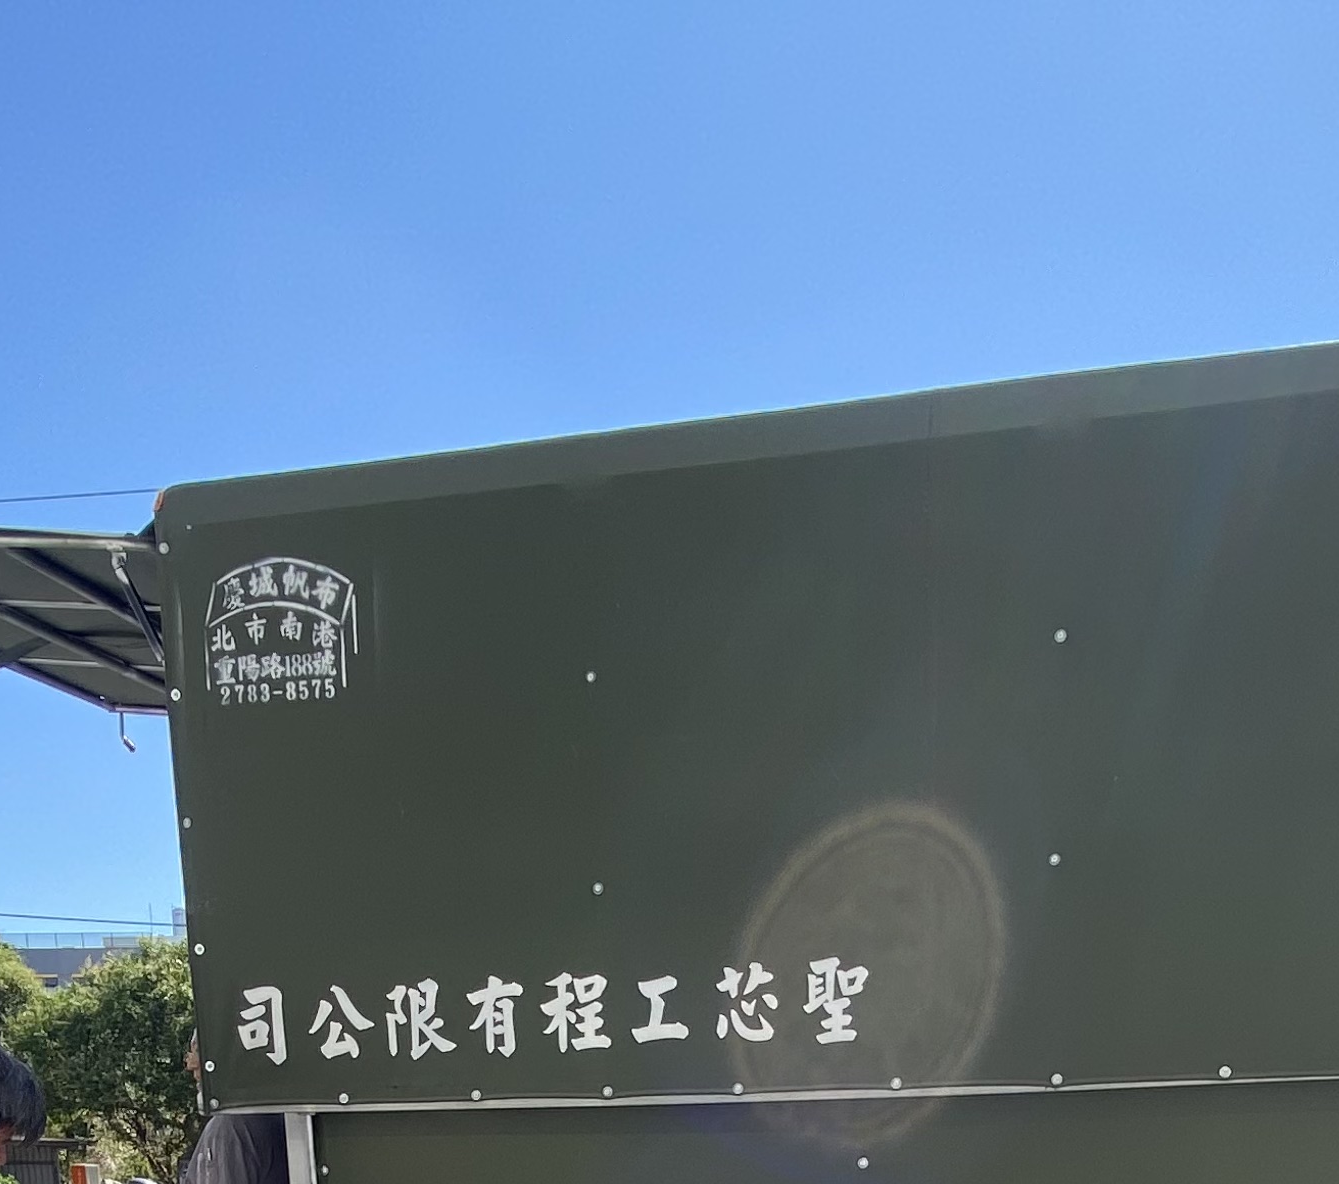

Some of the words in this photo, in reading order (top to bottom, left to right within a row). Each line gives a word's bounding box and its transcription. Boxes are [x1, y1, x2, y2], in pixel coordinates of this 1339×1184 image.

[211, 610, 338, 652] 北市南港
[219, 678, 337, 706] 2783-8575
